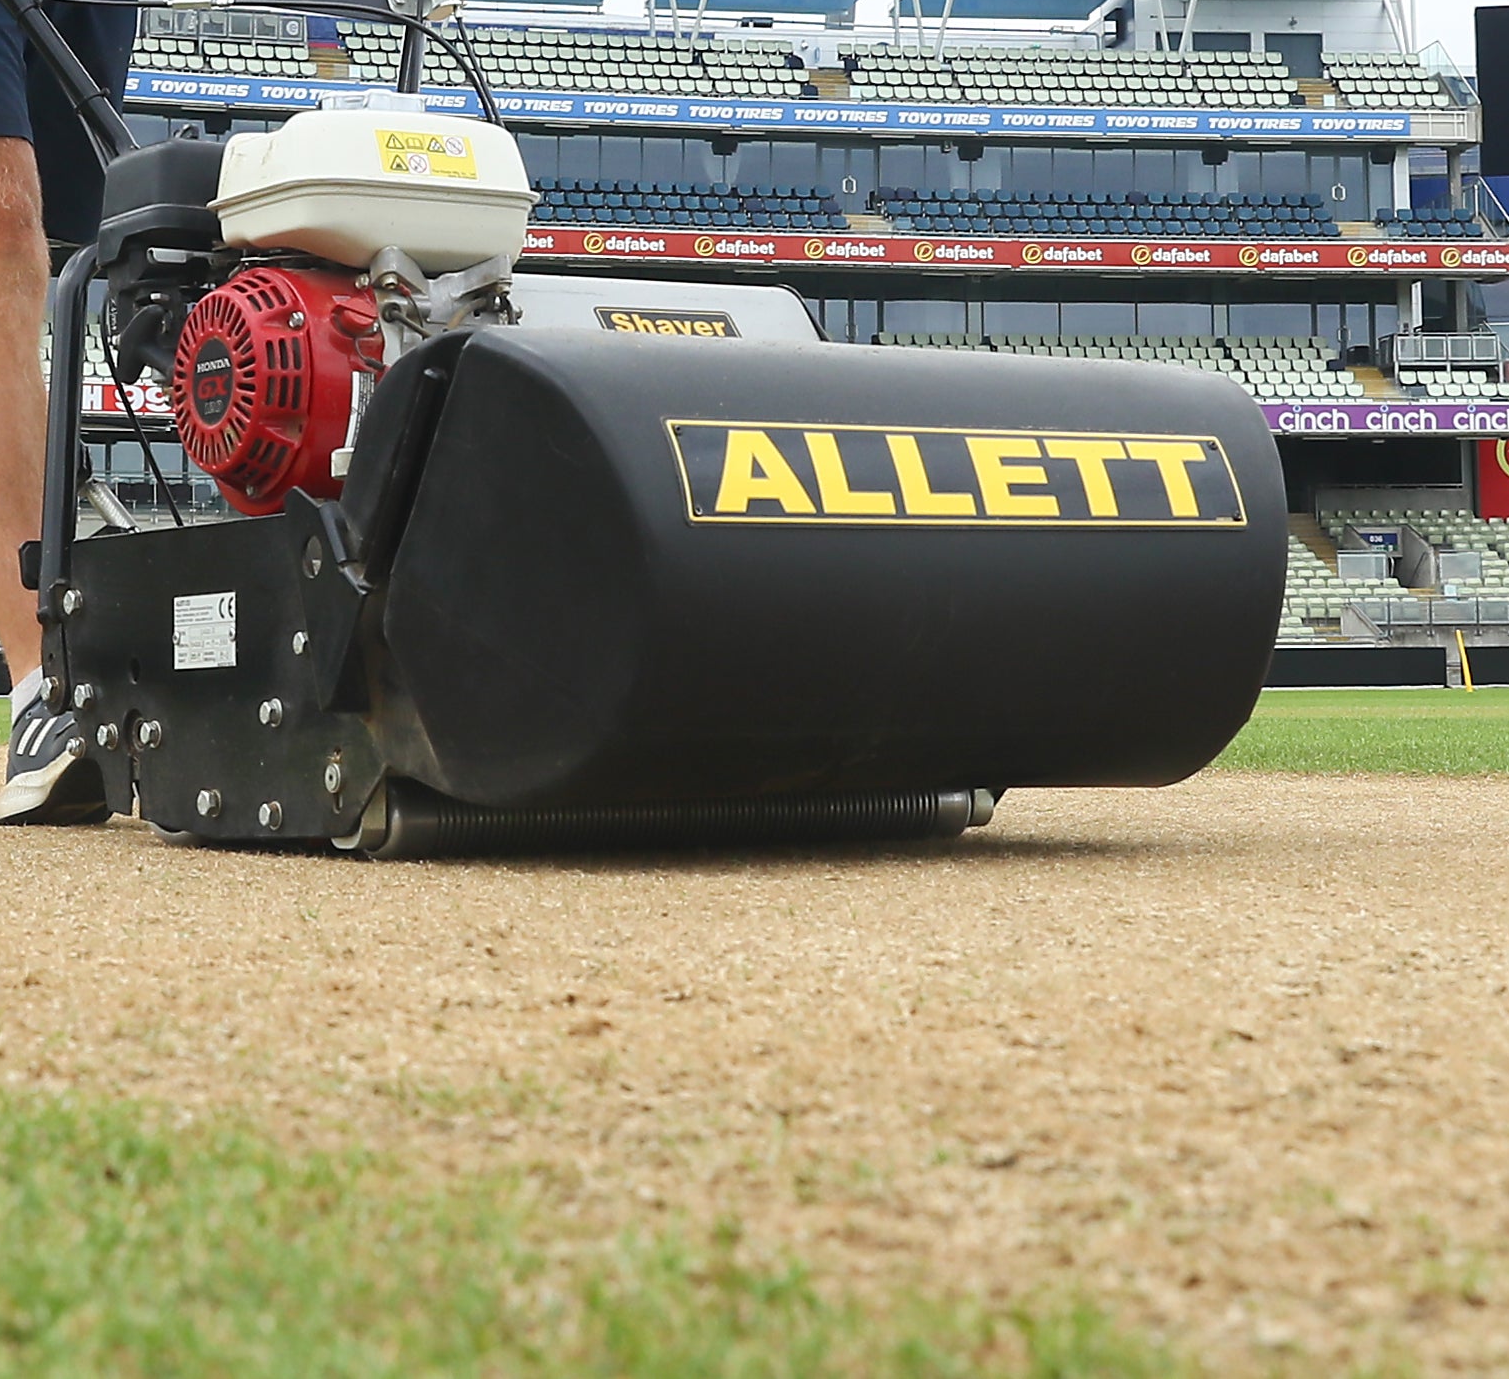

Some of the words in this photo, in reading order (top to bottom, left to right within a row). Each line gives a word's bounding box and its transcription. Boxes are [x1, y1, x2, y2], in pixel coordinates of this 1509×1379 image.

[151, 79, 199, 95] TOYO
[199, 83, 251, 98] TIRES
[261, 86, 308, 101] TOYO
[524, 99, 574, 113] TIRES
[584, 101, 630, 115] TOYO
[630, 103, 679, 117] TIRES
[689, 105, 734, 119] TOYO
[735, 107, 784, 120] TIRES
[794, 108, 839, 122] TOYO
[839, 110, 889, 123] TIRES
[898, 111, 943, 125] TOYO
[943, 113, 991, 126] TIRES
[1002, 114, 1046, 126] TOYO
[1047, 115, 1096, 128] TIRES
[1105, 115, 1150, 128] TOYO
[1150, 116, 1199, 129] TIRES
[1208, 117, 1253, 129] TOYO
[1253, 118, 1302, 130] TIRES
[1312, 118, 1356, 130] TOYO
[1356, 118, 1406, 131] TIRES
[605, 235, 666, 254] dafabet
[715, 238, 776, 257] dafabet
[826, 241, 885, 258] dafabet
[935, 243, 994, 261] dafabet
[1044, 246, 1103, 263] dafabet
[1152, 247, 1211, 264] dafabet
[1260, 248, 1319, 265] dafabet
[1369, 249, 1428, 265] dafabet
[610, 313, 727, 337] Shaver
[196, 357, 231, 374] HONDA
[197, 374, 229, 400] GX
[1278, 404, 1350, 431] cinch
[1366, 404, 1438, 431] cinch
[713, 429, 1208, 518] ALLETT
